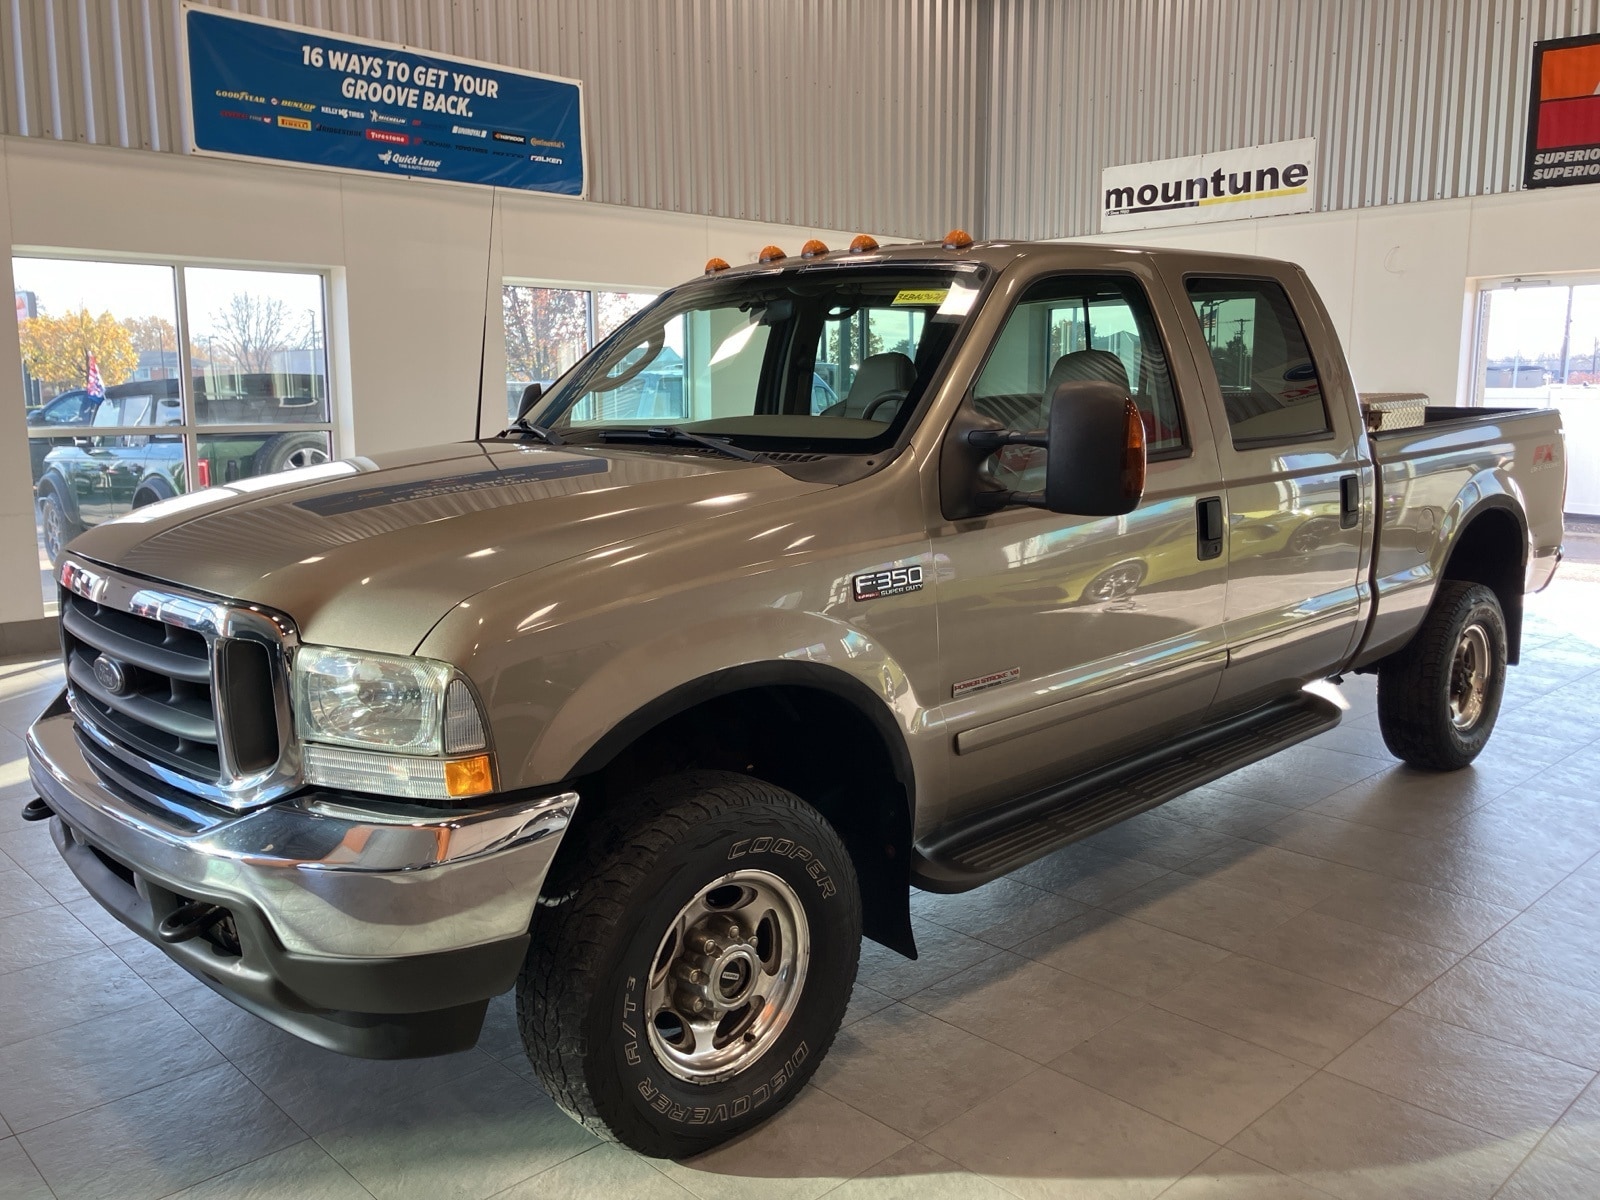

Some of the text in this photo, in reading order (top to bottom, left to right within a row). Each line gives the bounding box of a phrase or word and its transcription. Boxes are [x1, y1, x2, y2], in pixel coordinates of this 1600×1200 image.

[302, 45, 499, 99] 16 WAYS TO GET YOUR
[215, 90, 266, 104] GOODYEAR
[280, 99, 316, 111] DUNLOP
[341, 77, 474, 118] GROOVE BACK.
[378, 115, 406, 124] MICHELIN
[392, 153, 441, 167] Quick Lane
[1532, 163, 1600, 181] SUPERIO
[1105, 163, 1309, 209] mountune
[880, 587, 904, 597] SUPER
[905, 583, 923, 592] DUTY
[954, 679, 980, 691] POWER
[980, 671, 1009, 684] STROKE
[728, 836, 837, 900] COOPER
[637, 1040, 809, 1125] DISCOVERER
